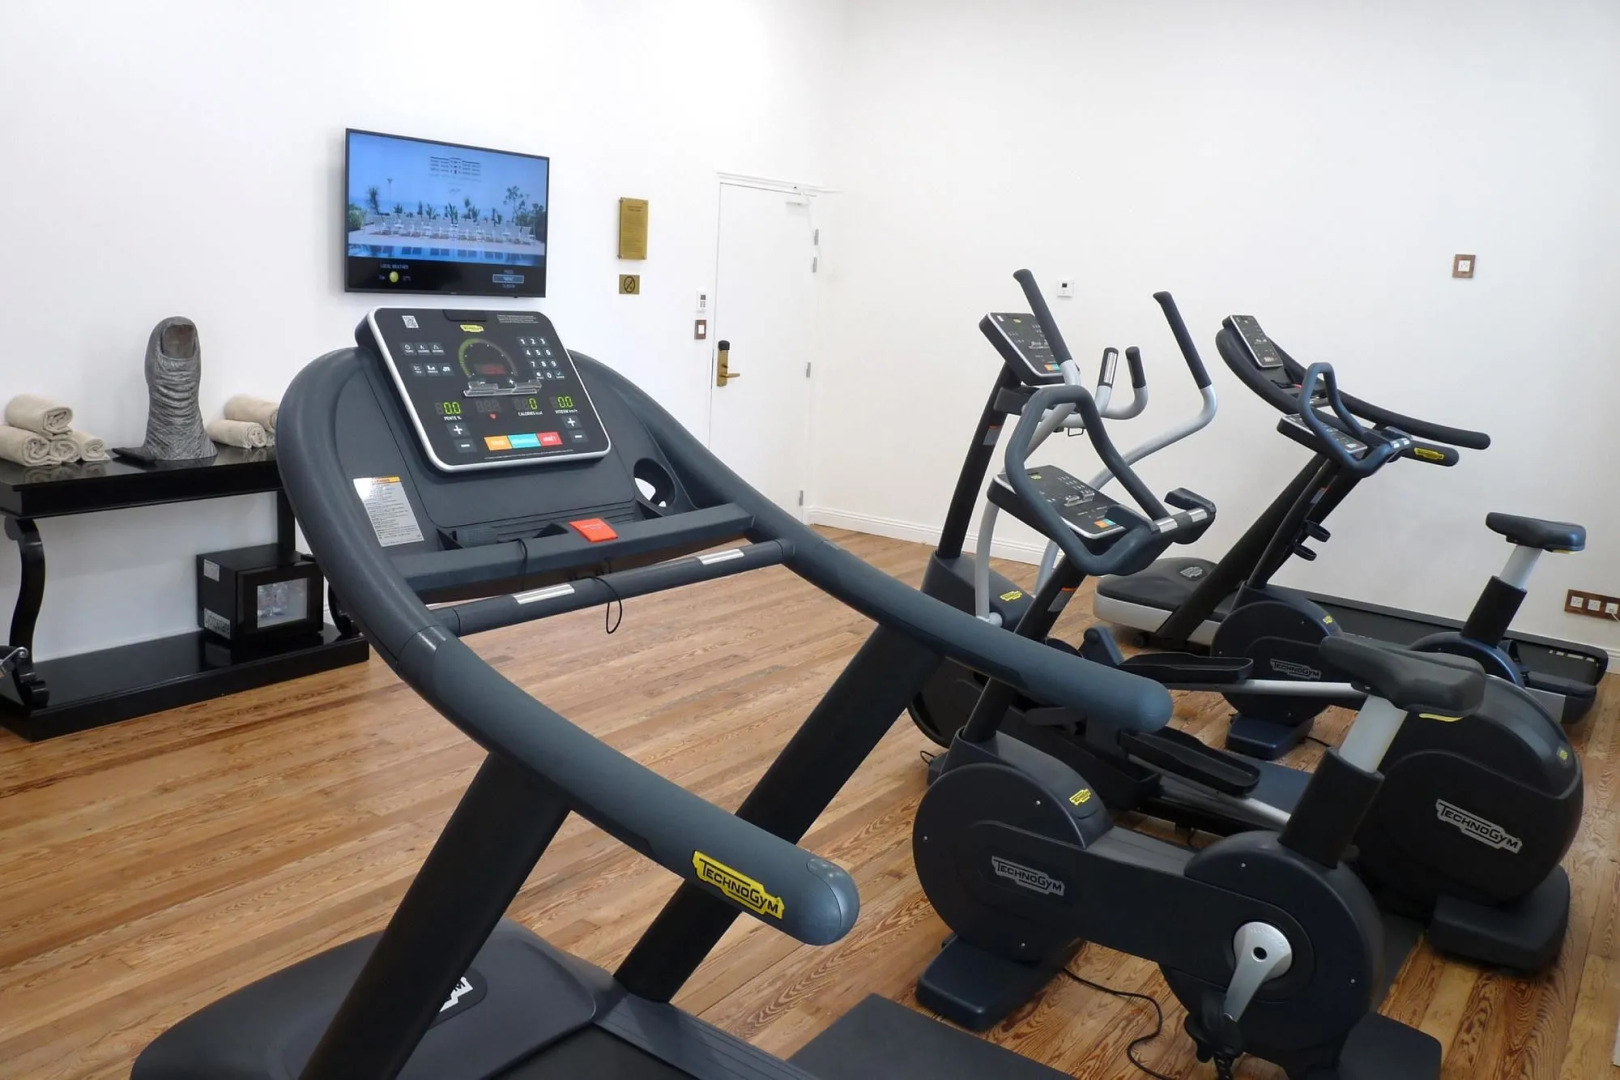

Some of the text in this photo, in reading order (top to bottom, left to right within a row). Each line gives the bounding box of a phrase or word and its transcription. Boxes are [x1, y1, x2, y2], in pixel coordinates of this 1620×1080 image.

[1439, 802, 1518, 850] TECHNOGYM
[699, 857, 779, 914] TECHNOGYM
[992, 858, 1063, 892] TECHNOGYM
